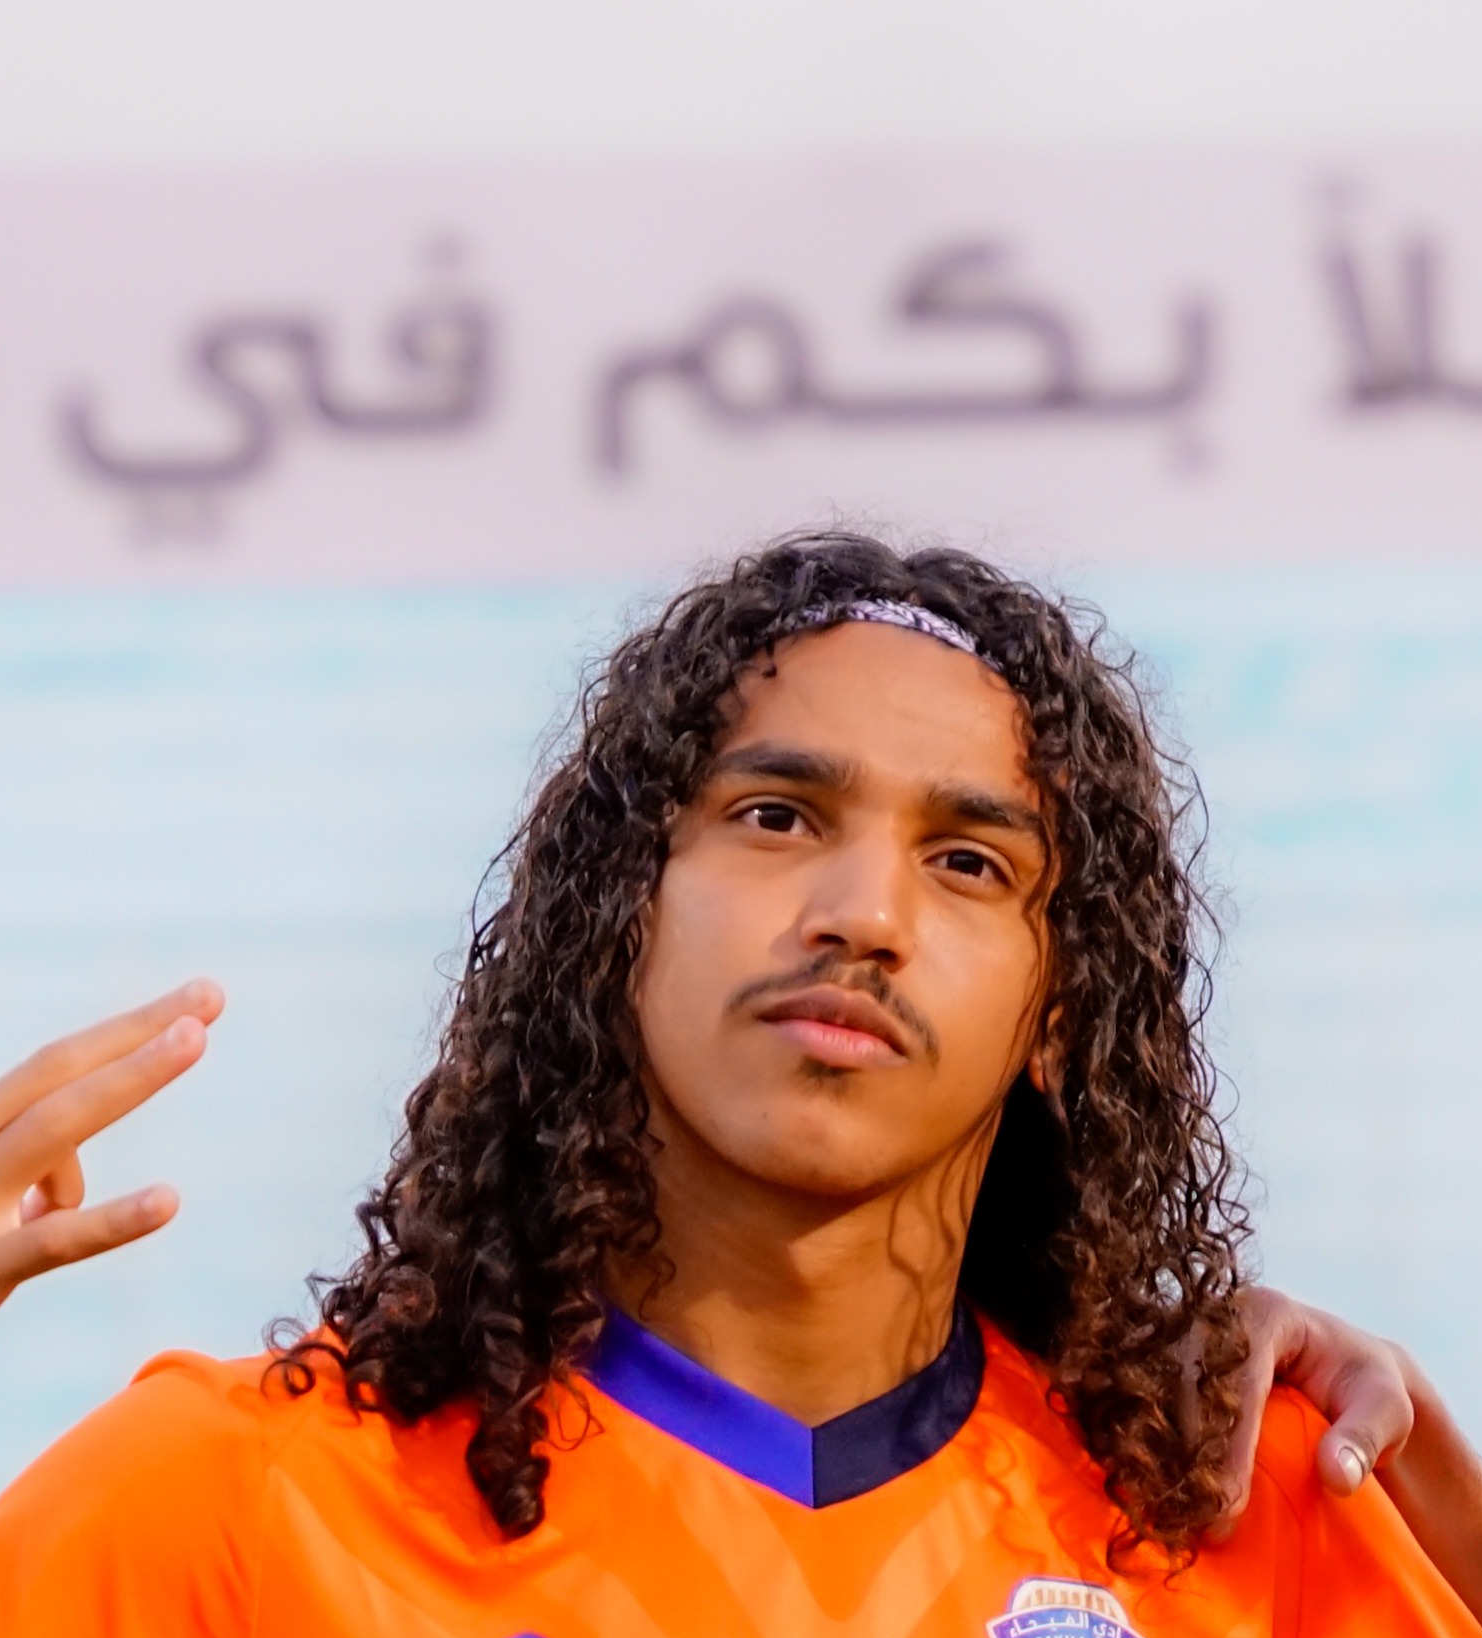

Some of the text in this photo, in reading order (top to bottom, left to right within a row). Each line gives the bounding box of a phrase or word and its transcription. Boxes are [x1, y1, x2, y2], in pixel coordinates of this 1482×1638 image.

[55, 238, 493, 550] في
[593, 238, 1218, 480] بكم
[1009, 1611, 1089, 1638] الفيحاء
